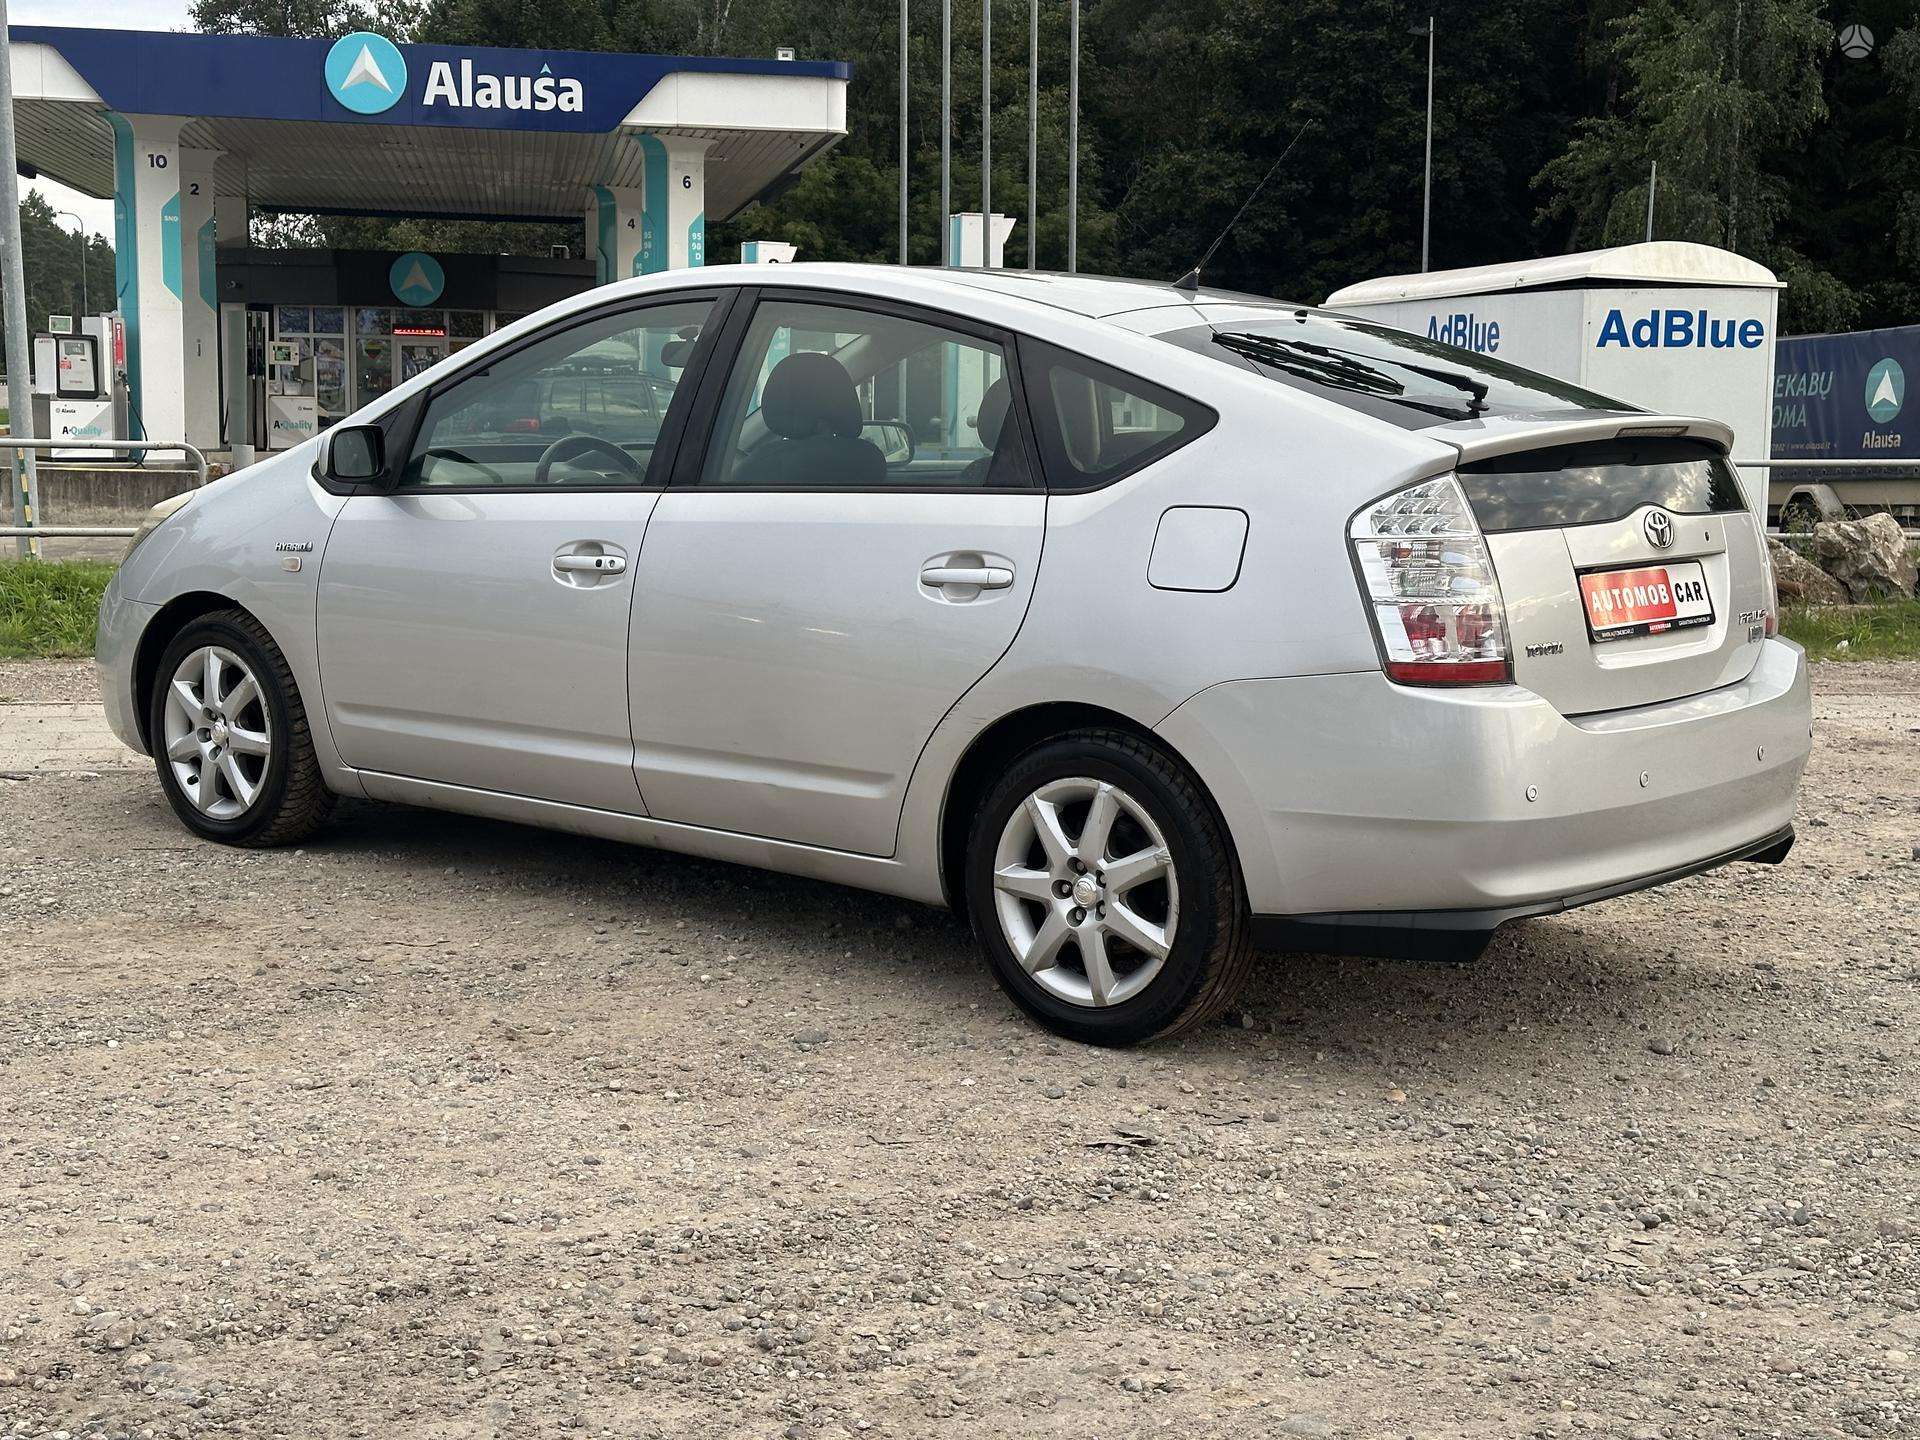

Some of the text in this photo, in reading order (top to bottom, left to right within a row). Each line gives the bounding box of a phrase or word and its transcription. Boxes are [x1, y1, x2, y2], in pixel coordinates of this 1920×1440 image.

[147, 153, 168, 169] 10
[189, 183, 200, 196] 2
[682, 175, 692, 189] 6
[627, 218, 636, 230] 4
[691, 232, 702, 240] 95
[1427, 312, 1500, 353] AdBlue
[1596, 309, 1765, 348] AdBlue
[1774, 371, 1834, 400] EKABŲ
[1772, 404, 1807, 429] OMA
[1591, 580, 1704, 613] AUTOMOB CAR
